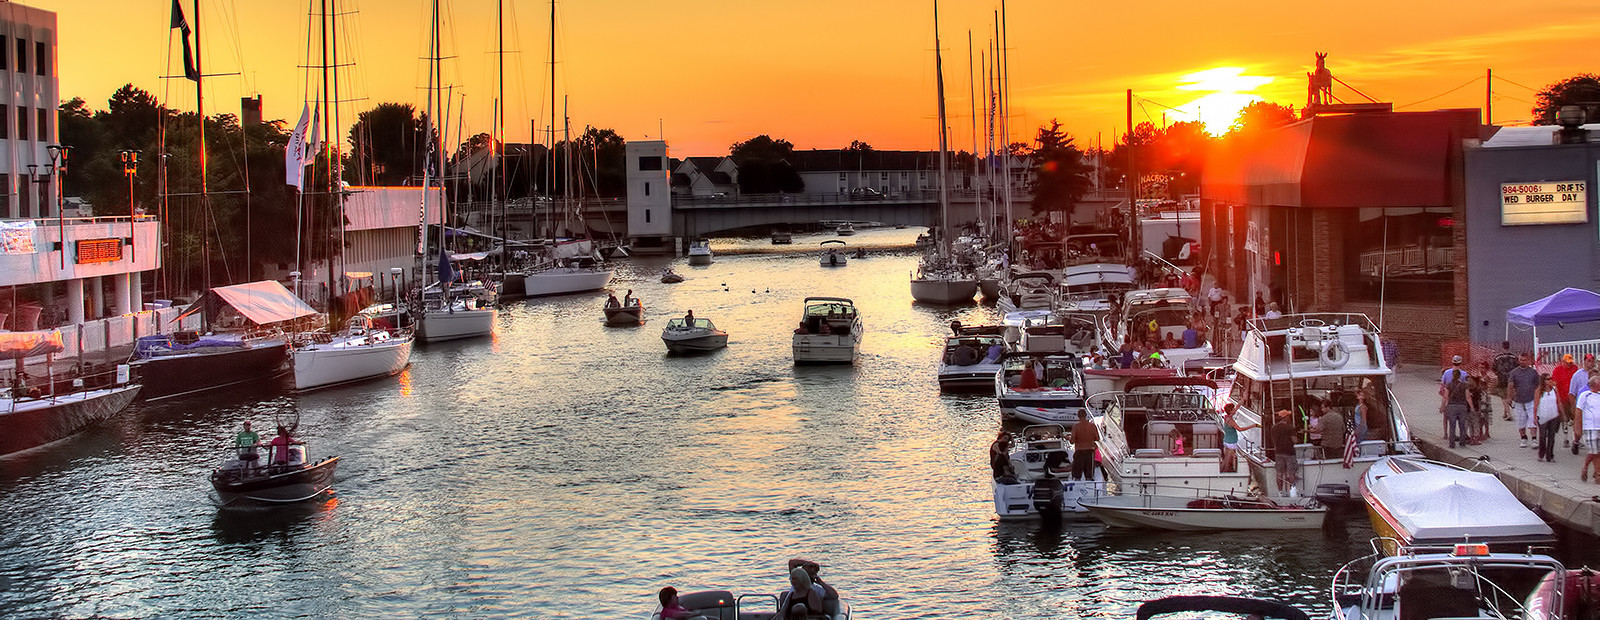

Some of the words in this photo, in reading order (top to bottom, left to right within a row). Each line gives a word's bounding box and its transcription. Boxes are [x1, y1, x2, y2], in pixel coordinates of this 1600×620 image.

[1556, 183, 1585, 192] DRAFTS
[1504, 195, 1519, 204] WED
[1525, 194, 1554, 203] BURGER
[1562, 193, 1578, 202] DAY
